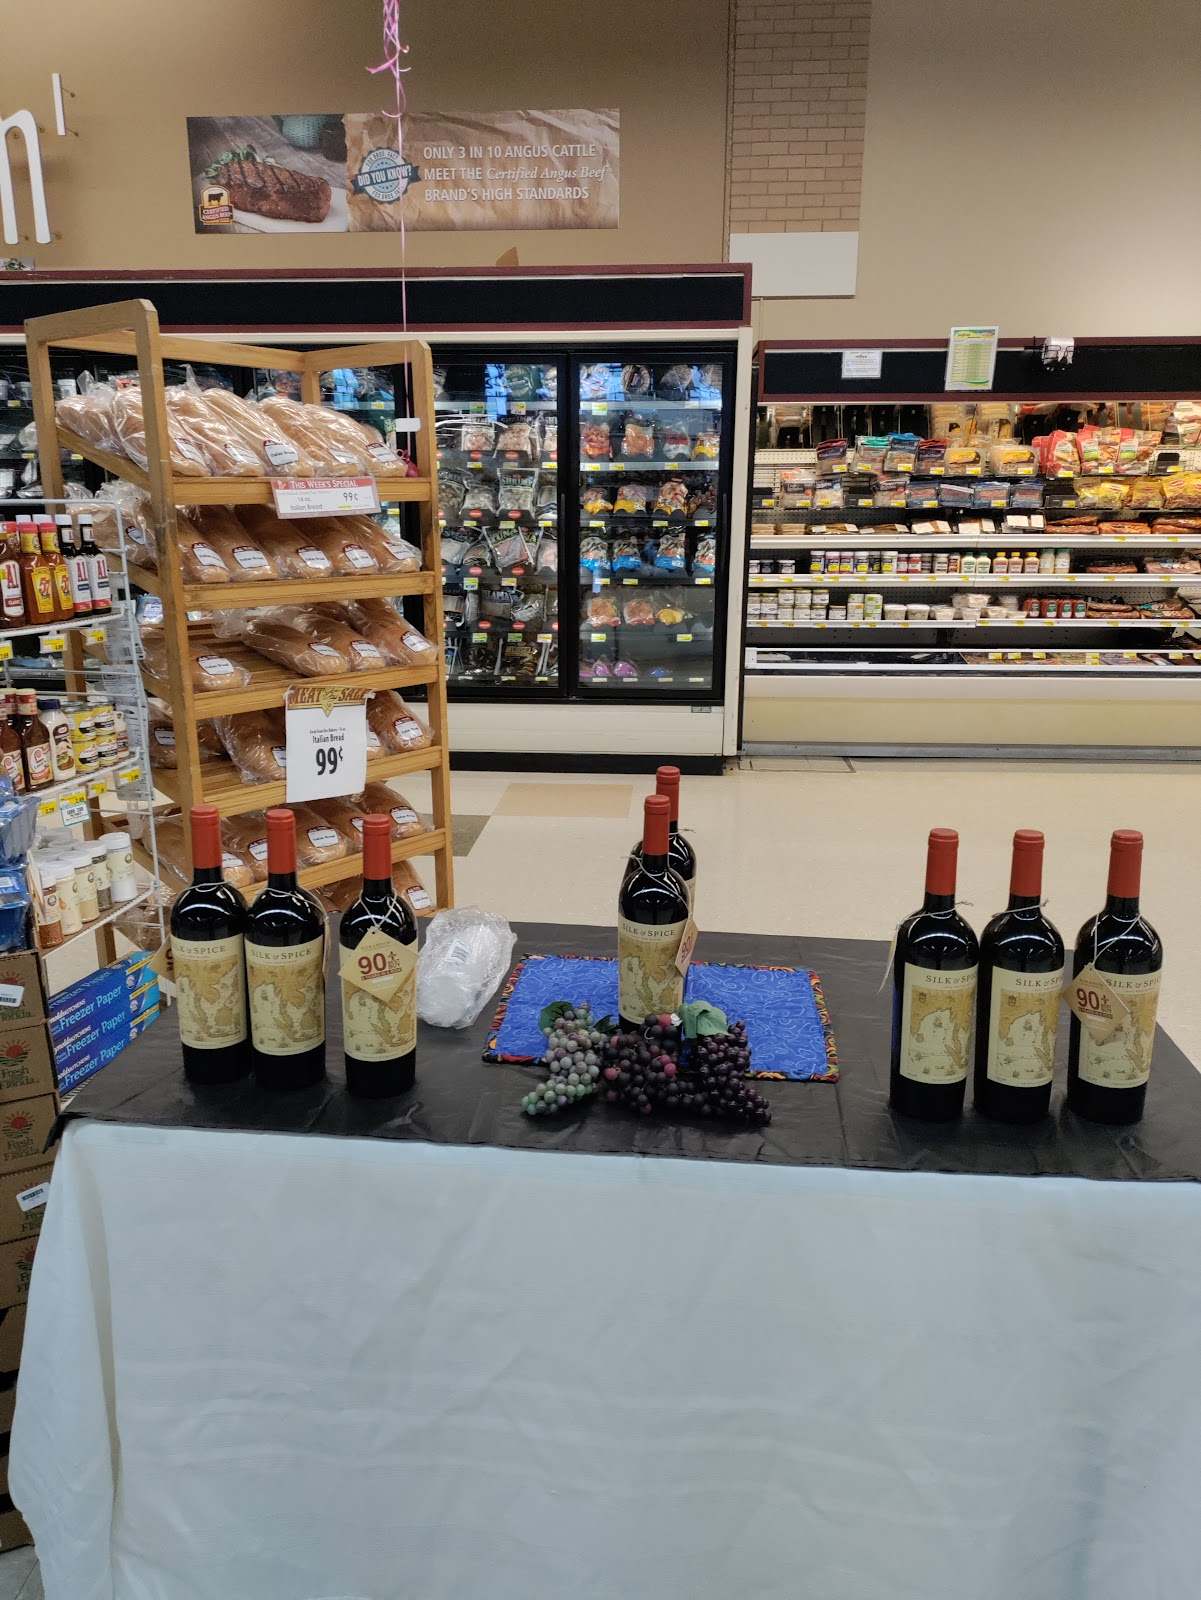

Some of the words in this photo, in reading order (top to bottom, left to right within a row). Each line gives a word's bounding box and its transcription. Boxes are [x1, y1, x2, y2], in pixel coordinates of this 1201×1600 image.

[424, 146, 454, 159] ONLY
[458, 146, 466, 158] 3
[470, 146, 482, 158] IN
[487, 146, 502, 158] 10
[504, 145, 548, 158] ANGUS
[552, 144, 596, 157] CATTLE
[358, 174, 370, 186] DID
[370, 170, 386, 183] YOU
[386, 164, 412, 181] KNOW?
[424, 168, 456, 180] MEET
[461, 168, 482, 180] THE
[487, 166, 538, 182] Certified
[540, 168, 577, 182] Angus
[580, 164, 607, 181] Beef
[424, 188, 478, 201] BRAND'S
[482, 188, 512, 200] HIGH
[516, 186, 590, 200] STANDARDS
[290, 480, 306, 489] THIS
[332, 480, 358, 488] SPECIAL
[312, 734, 330, 744] Italian
[330, 732, 344, 742] Bread
[192, 946, 225, 954] SPICE
[281, 949, 312, 960] SPICE
[926, 975, 952, 984] SILK
[1016, 978, 1042, 986] SILK
[1105, 979, 1133, 988] SILK
[60, 1002, 95, 1030] Freezer
[96, 986, 122, 1008] Paper
[66, 1028, 100, 1056] Freezer
[101, 1011, 126, 1034] Paper
[64, 1056, 98, 1087] Freezer
[100, 1039, 125, 1061] Paper
